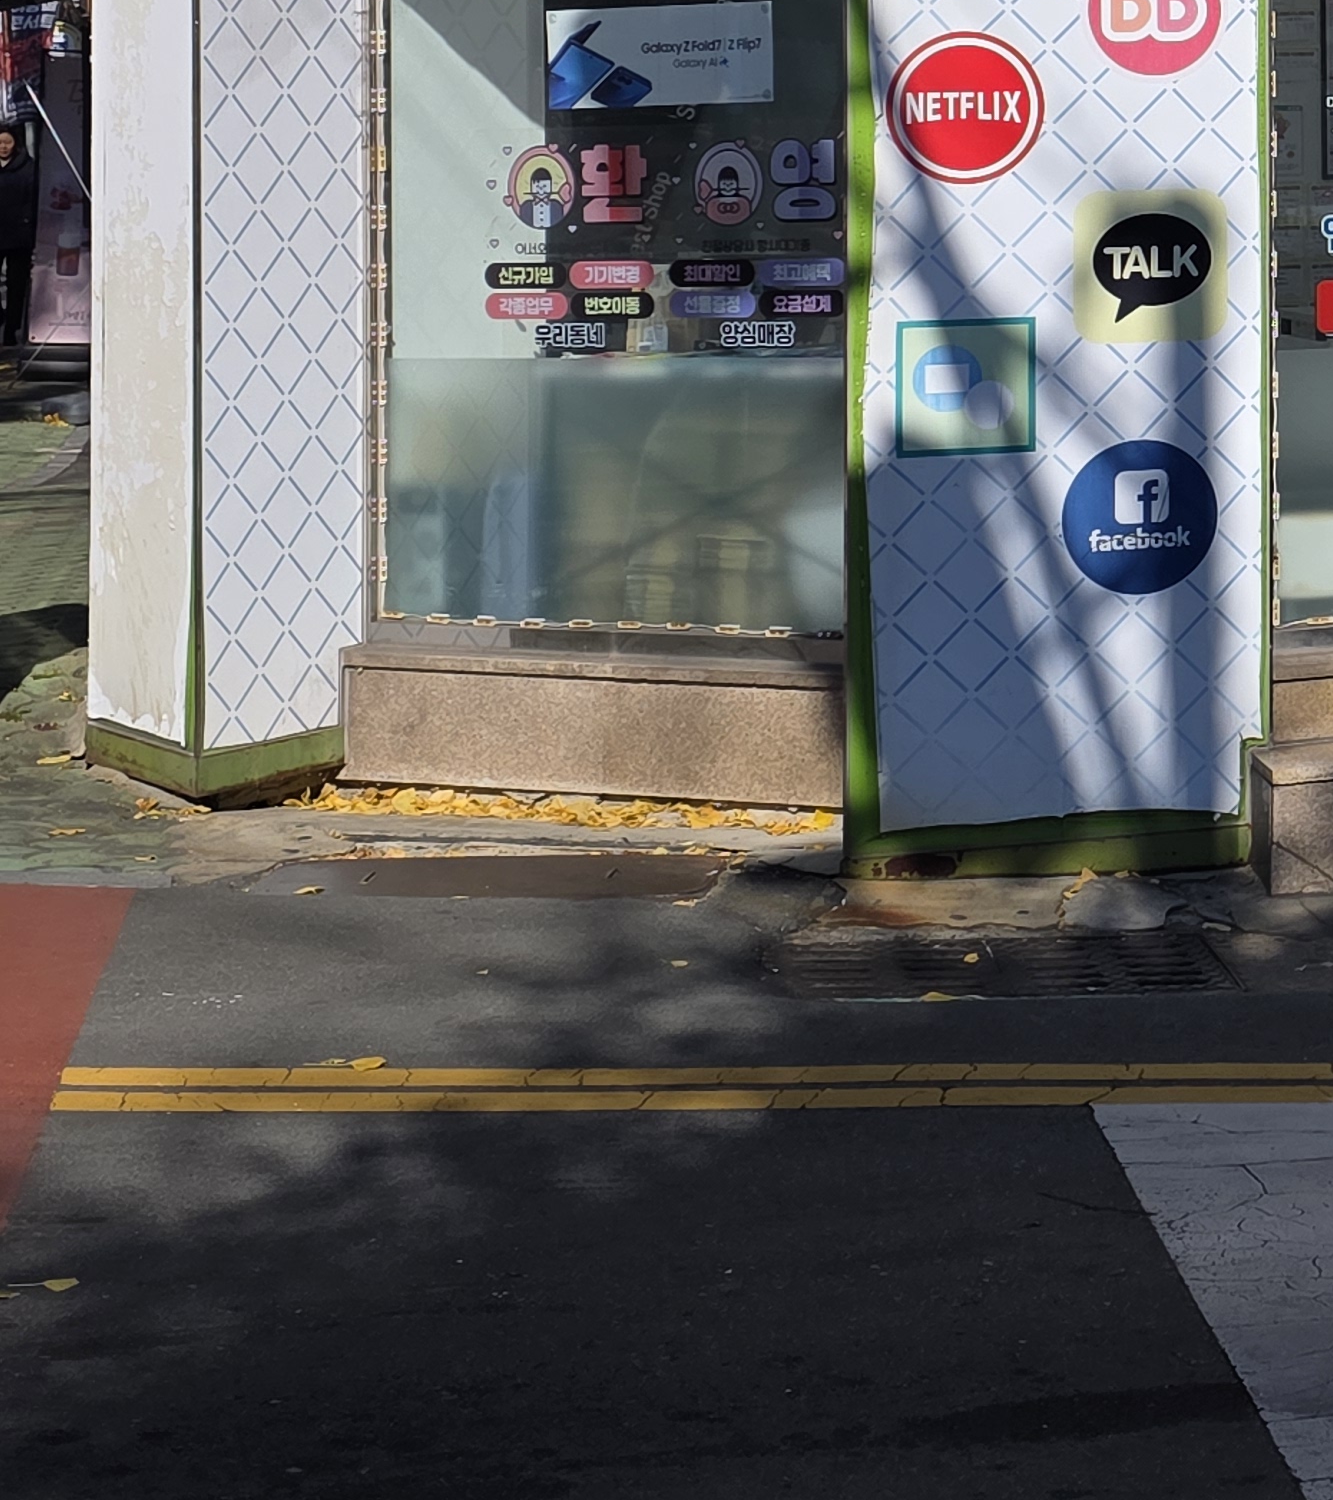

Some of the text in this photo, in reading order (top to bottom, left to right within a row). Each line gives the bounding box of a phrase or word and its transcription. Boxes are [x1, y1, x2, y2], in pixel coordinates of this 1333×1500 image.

[641, 37, 762, 56] Galaxy Z Fold7 Z Flip7
[672, 58, 707, 70] Galaxy
[906, 90, 1021, 124] NETFLIX
[580, 139, 838, 224] 환 영
[1103, 244, 1199, 279] TALK
[498, 267, 554, 285] 신규가입
[584, 266, 640, 284] 기기변경
[683, 264, 741, 283] 최대할인
[499, 298, 554, 316] 각종업무
[584, 297, 641, 315] 번호이동
[772, 296, 831, 314] 요금설계
[534, 324, 606, 349] 우리동네
[719, 322, 795, 348] 양심매장
[1089, 526, 1190, 552] facebook
